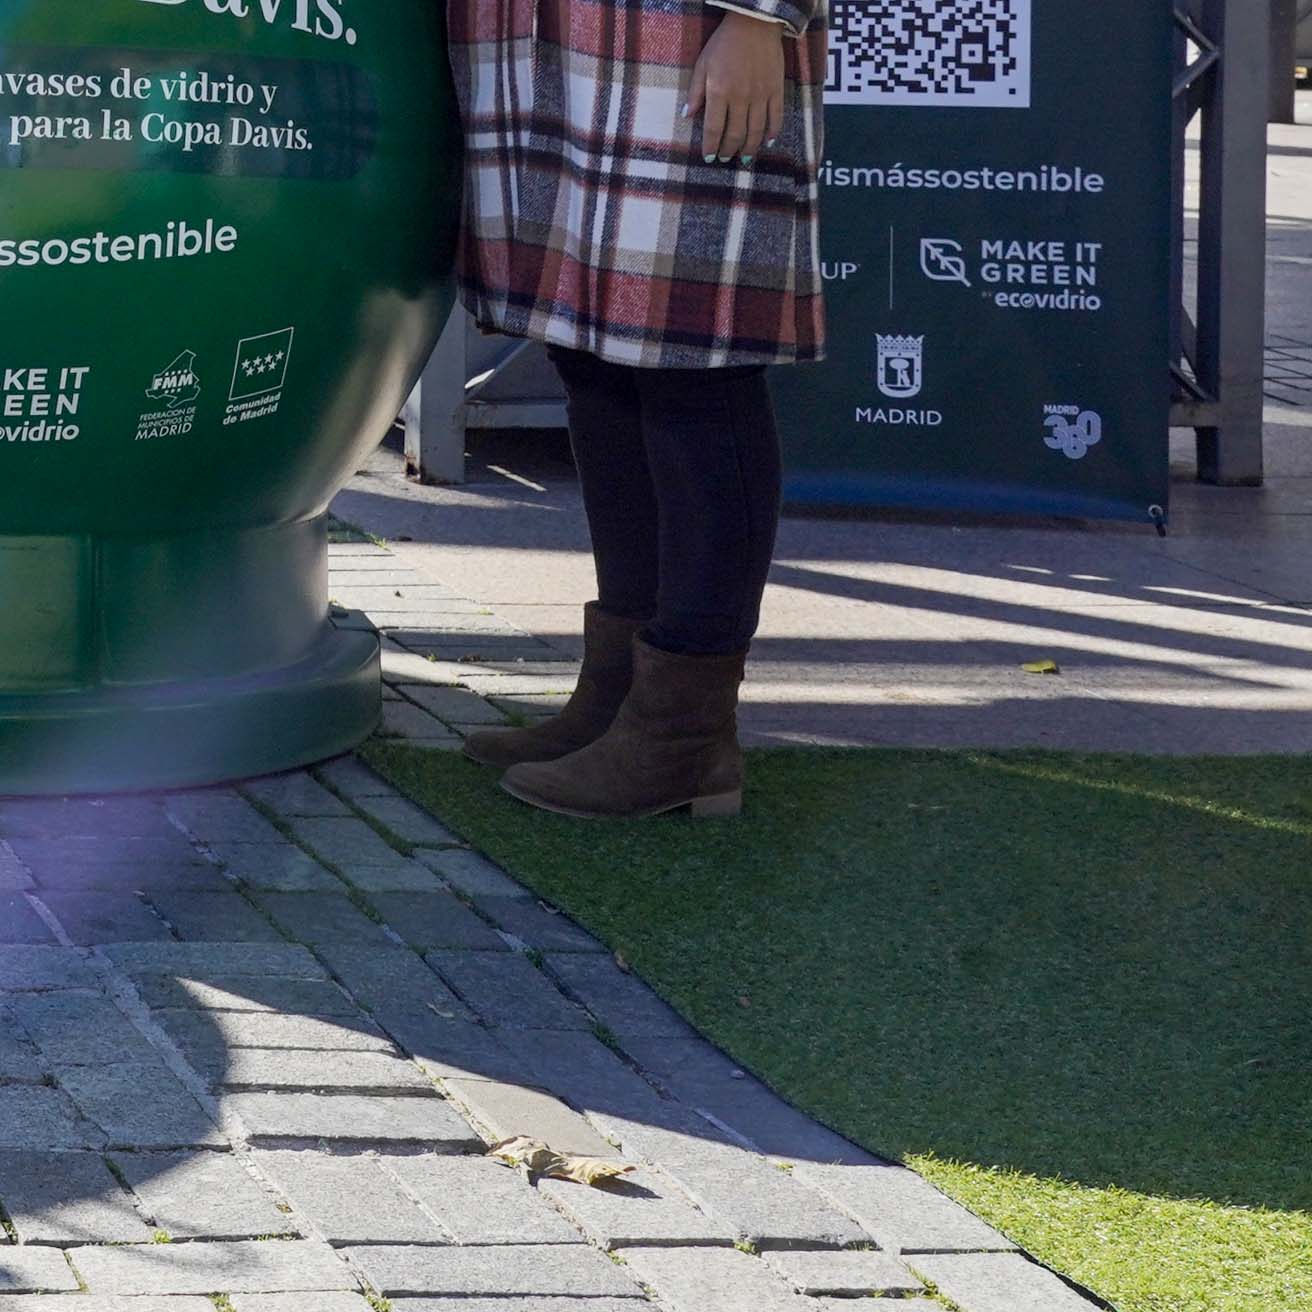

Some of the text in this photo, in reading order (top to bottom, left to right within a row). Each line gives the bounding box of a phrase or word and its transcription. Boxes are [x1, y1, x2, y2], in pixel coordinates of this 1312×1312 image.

[110, 68, 151, 100] de
[159, 72, 254, 105] vidrio
[260, 84, 278, 115] y
[9, 115, 92, 146] para
[100, 110, 133, 141] la
[140, 112, 223, 151] Copa
[229, 119, 314, 151] Davis.
[818, 160, 1105, 193] ismássostenible
[981, 240, 1102, 263] MAKE IT
[821, 262, 858, 280] UP
[980, 263, 1096, 286] GREEN
[994, 289, 1101, 311] ecovidrio
[59, 367, 90, 389] IT
[152, 373, 193, 390] FMM
[225, 391, 281, 414] Comunidad
[1043, 404, 1080, 415] MADRID
[222, 403, 278, 425] de Madrid
[856, 407, 943, 426] MADRID
[135, 422, 192, 440] MADRID
